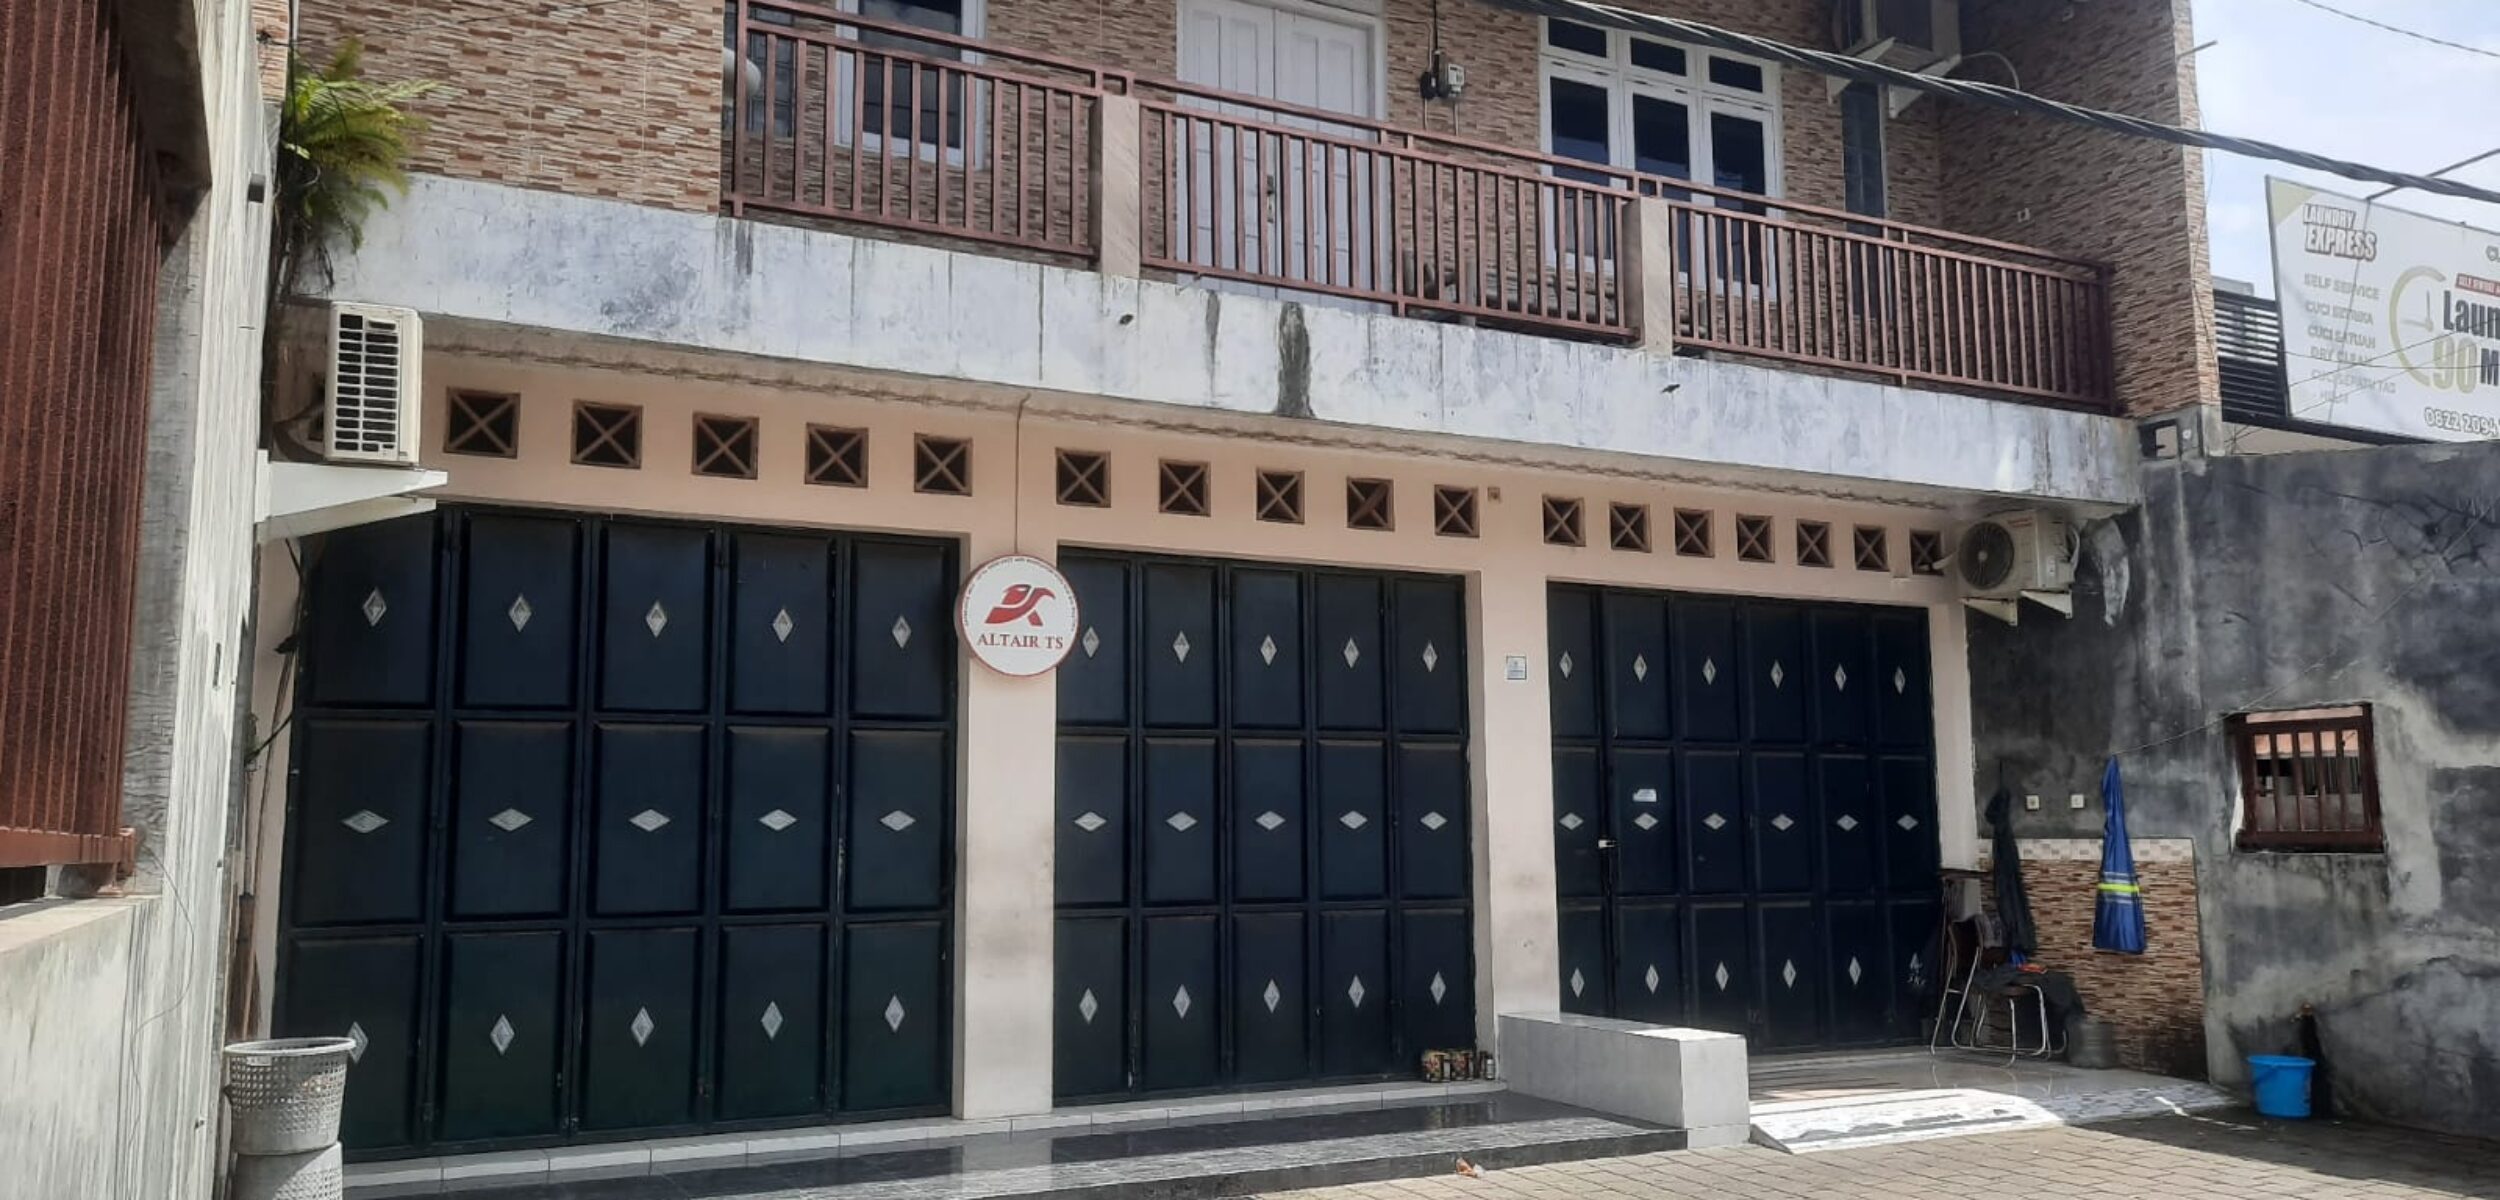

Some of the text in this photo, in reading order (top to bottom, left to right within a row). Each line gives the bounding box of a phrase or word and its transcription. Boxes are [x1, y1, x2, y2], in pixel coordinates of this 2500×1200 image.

[2303, 203, 2356, 230] LAUNDRY
[2305, 225, 2377, 261] EXPRESS
[2433, 336, 2477, 394] 90
[2425, 407, 2461, 431] 0822
[977, 634, 1063, 649] ALTAIR TS
